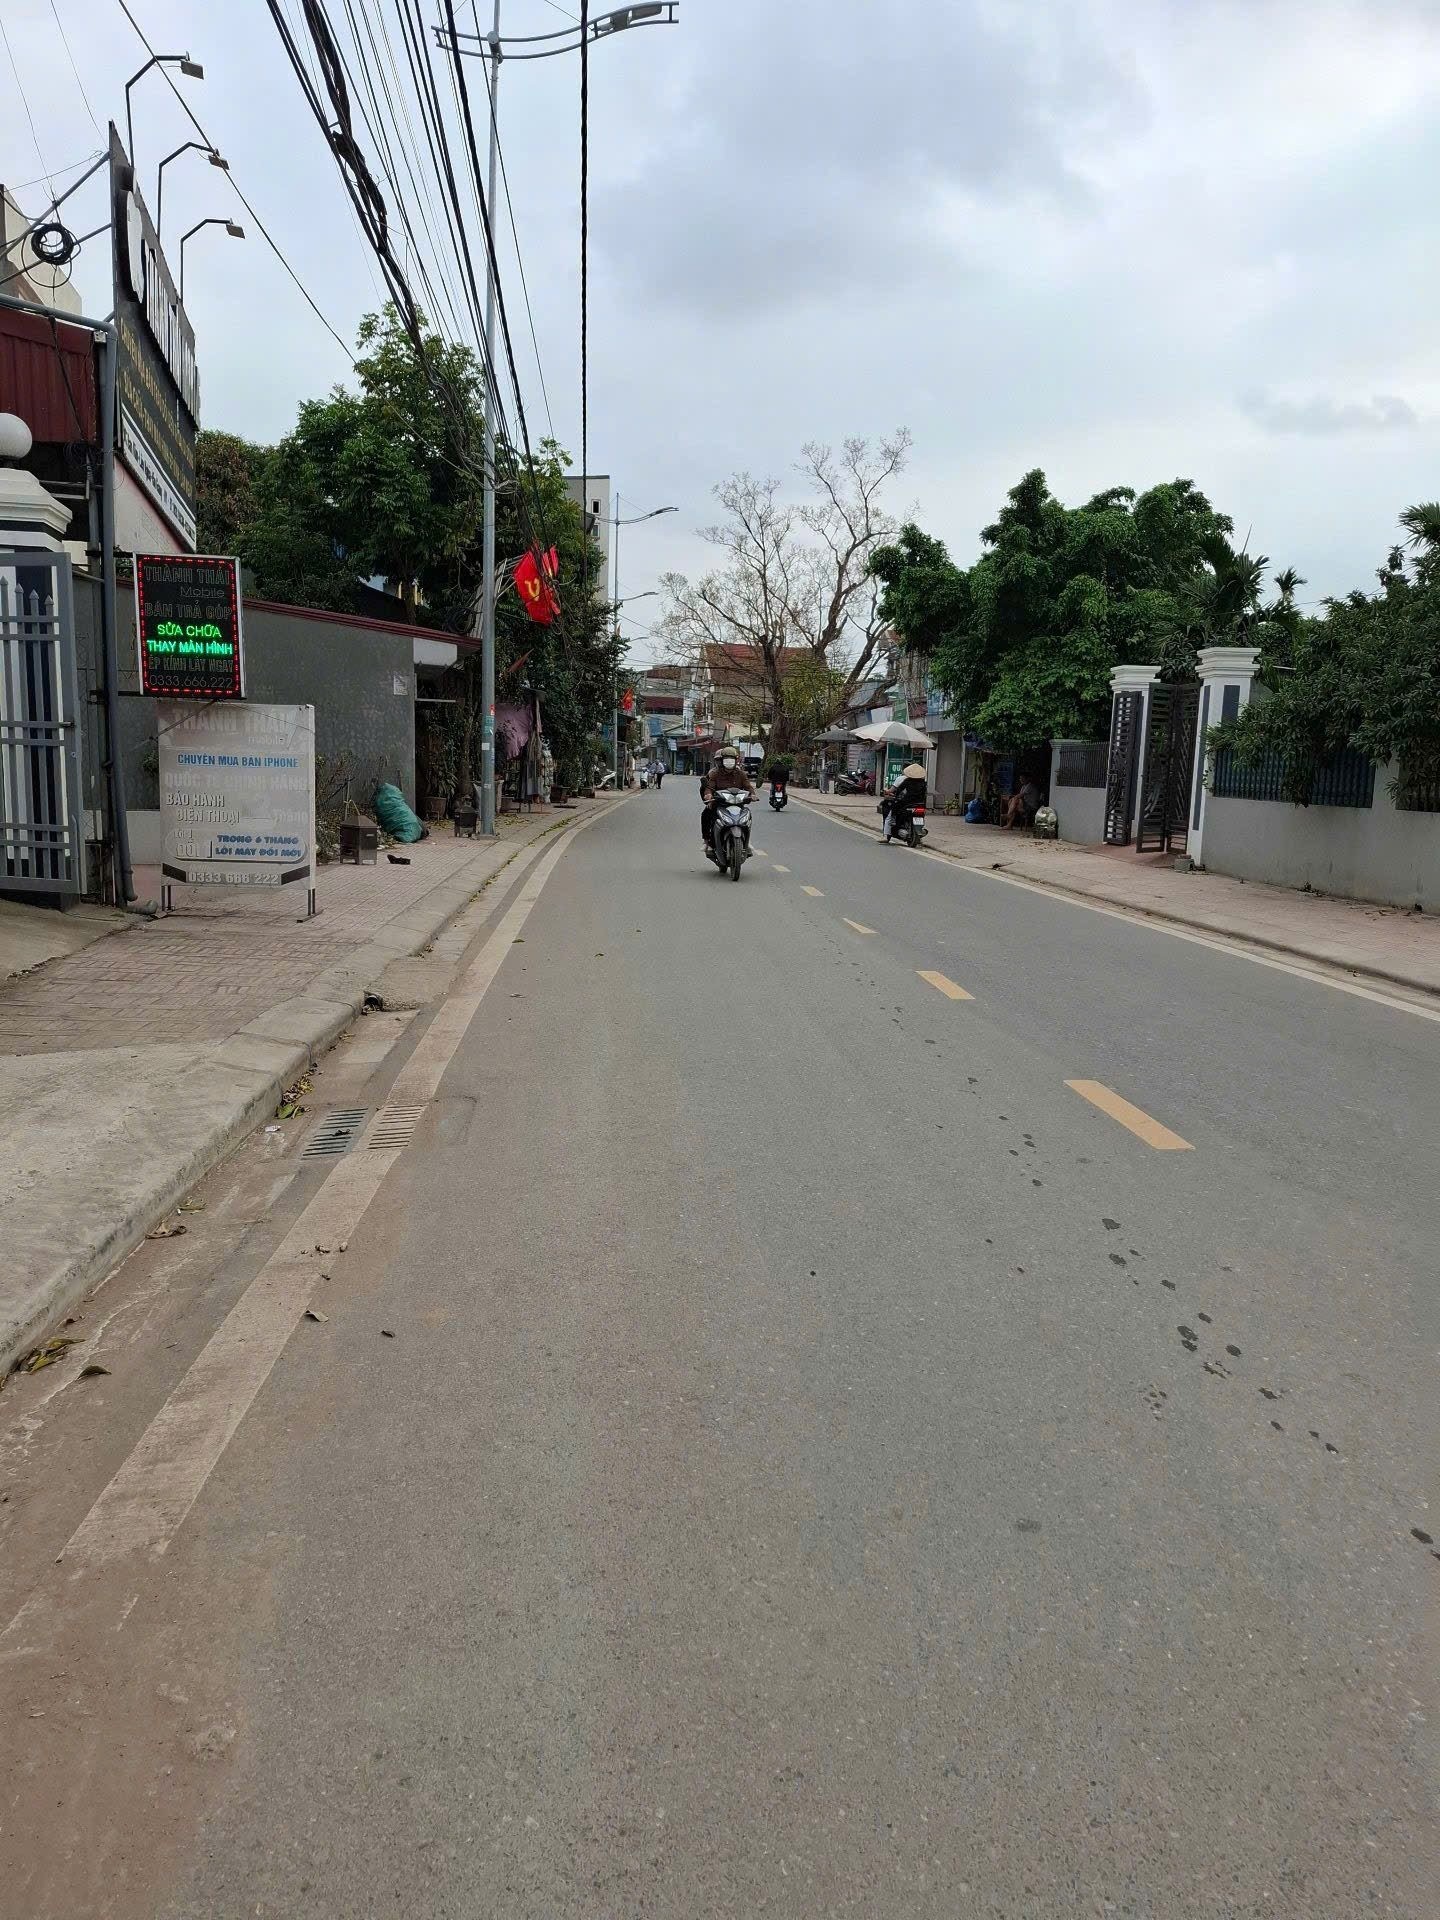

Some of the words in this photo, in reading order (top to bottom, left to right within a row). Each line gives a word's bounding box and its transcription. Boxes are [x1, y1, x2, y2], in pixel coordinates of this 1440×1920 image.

[144, 563, 193, 582] THÀNH
[180, 586, 225, 599] Mobile
[176, 600, 202, 619] TRẢ
[157, 621, 184, 636] SỬA
[186, 624, 222, 638] CHỮA
[146, 639, 176, 652] THAY
[179, 639, 204, 653] MÀN
[206, 640, 233, 655] HÌNH
[209, 658, 233, 672] NGAY
[150, 674, 233, 688] 0333.666.222
[178, 753, 215, 765] CHUYÊN
[218, 755, 239, 766] MUA
[264, 757, 299, 768] IPHONE
[217, 835, 252, 844] TRONG
[255, 836, 262, 844] 6
[188, 872, 221, 883] 0333
[254, 872, 279, 884] 222
